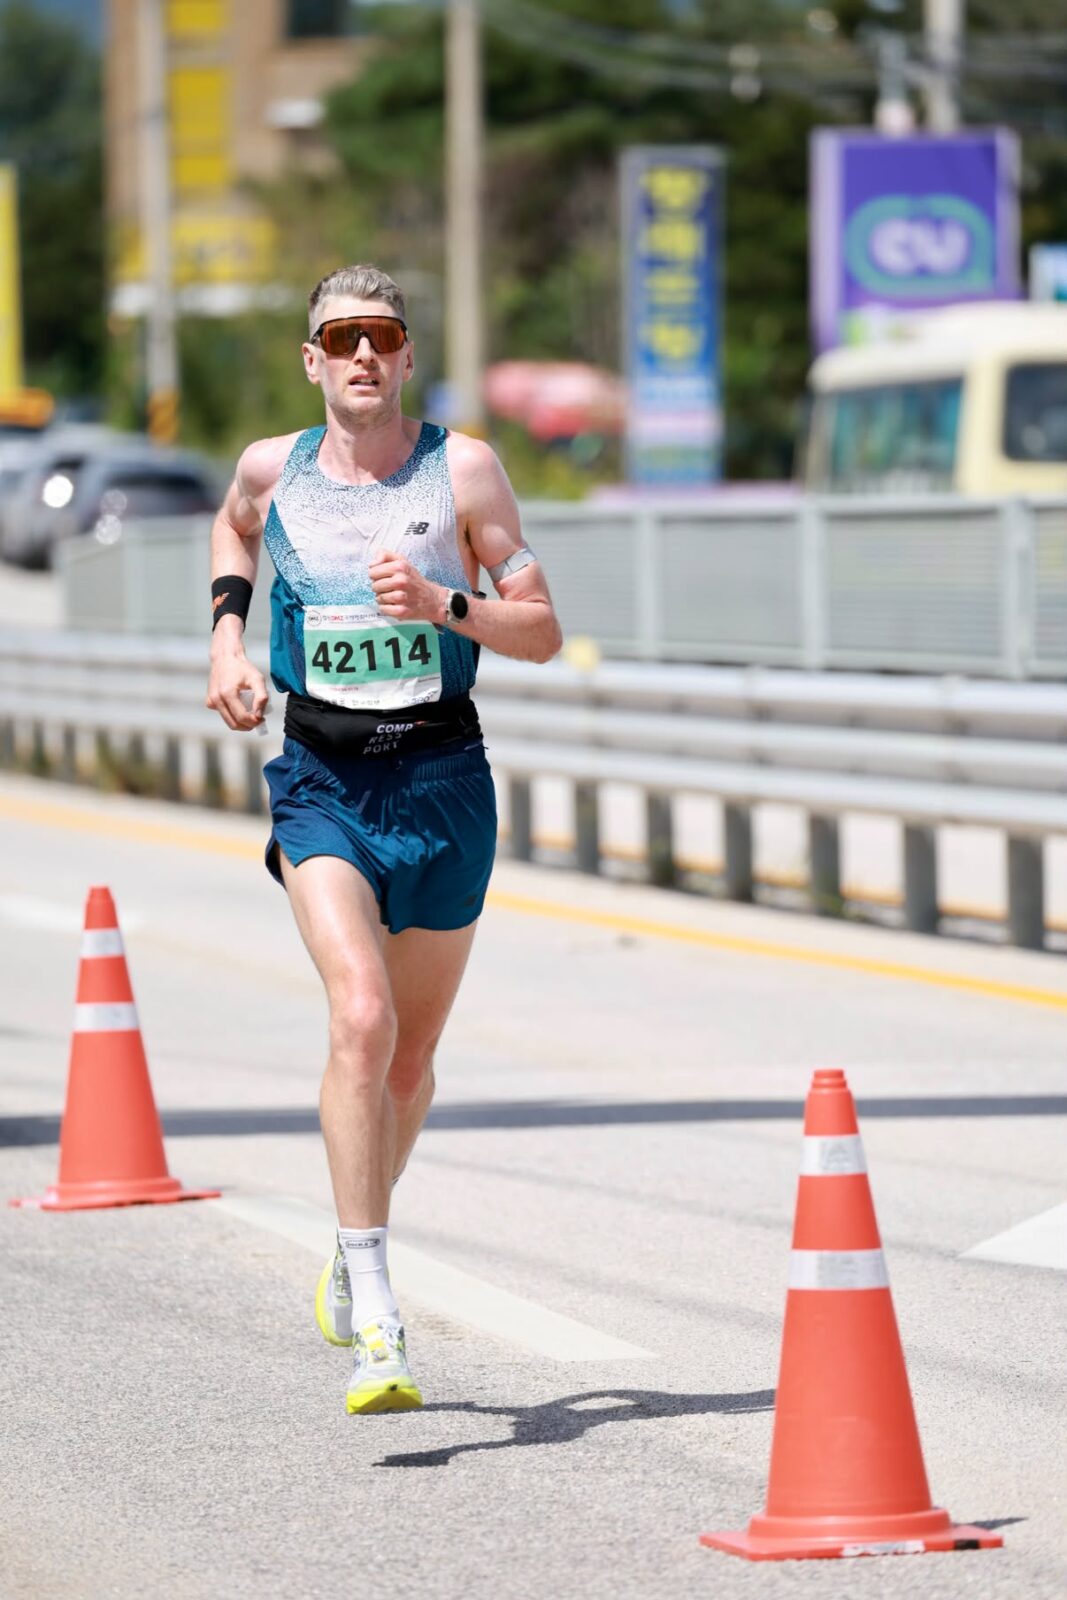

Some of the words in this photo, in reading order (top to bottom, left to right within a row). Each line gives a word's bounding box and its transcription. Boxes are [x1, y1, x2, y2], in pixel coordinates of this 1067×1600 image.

[869, 214, 970, 276] CU
[311, 633, 432, 674] 42114
[376, 723, 414, 734] COMP
